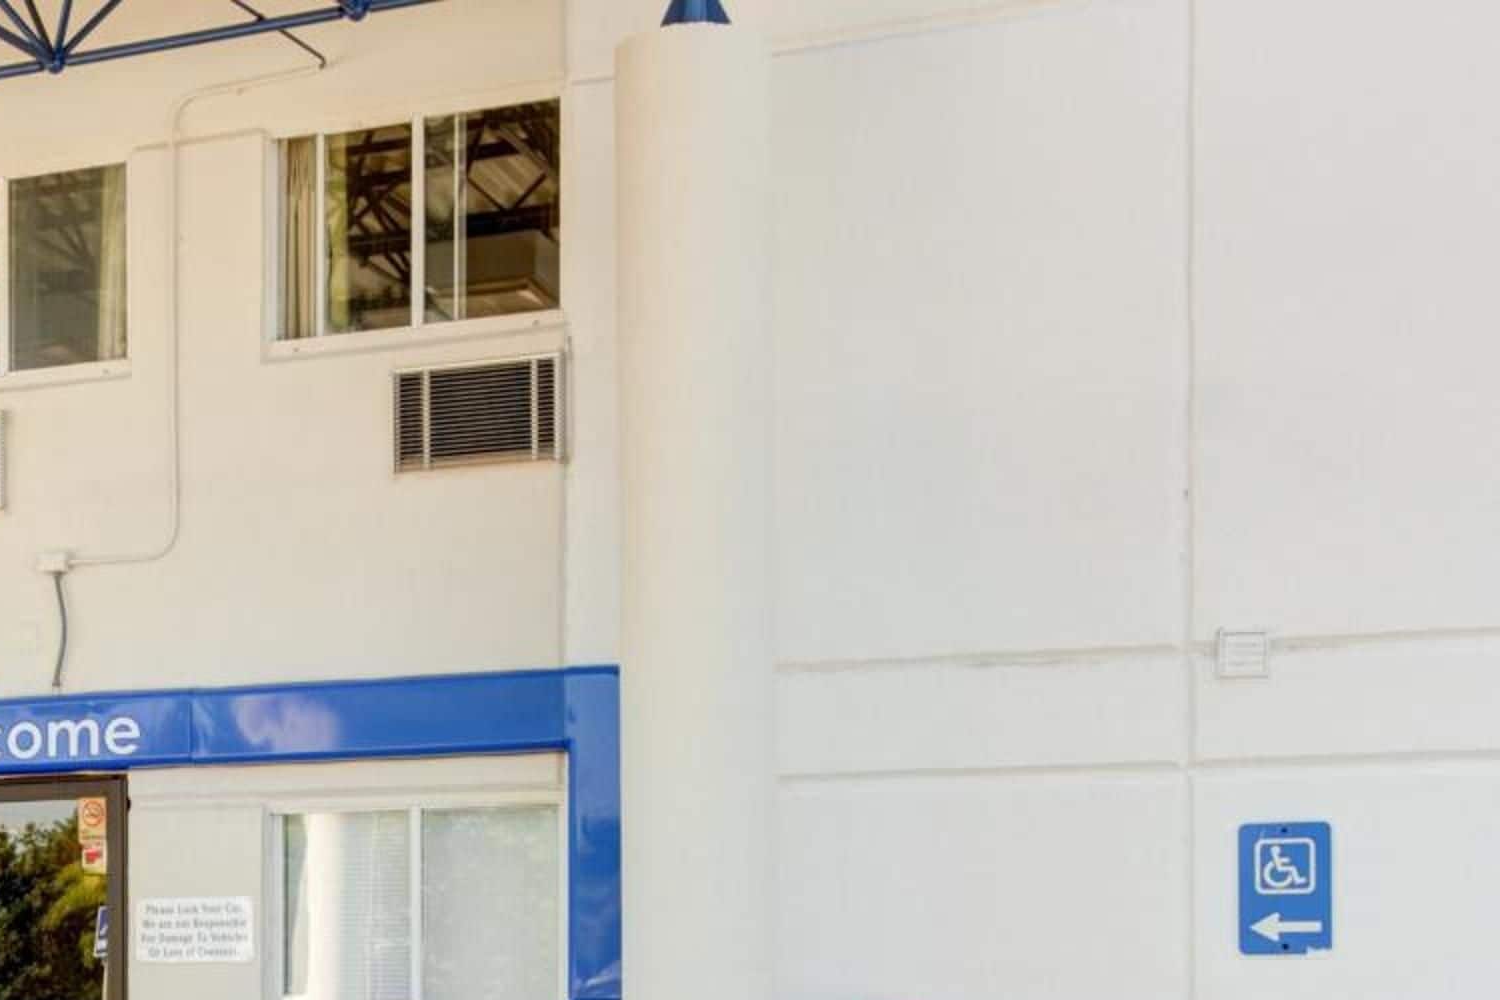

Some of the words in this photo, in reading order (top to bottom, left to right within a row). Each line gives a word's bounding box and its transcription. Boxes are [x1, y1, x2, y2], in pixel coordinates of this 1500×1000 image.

[145, 902, 174, 915] Please
[177, 902, 198, 914] Lock
[193, 916, 247, 930] Responsible
[159, 931, 193, 946] Damage
